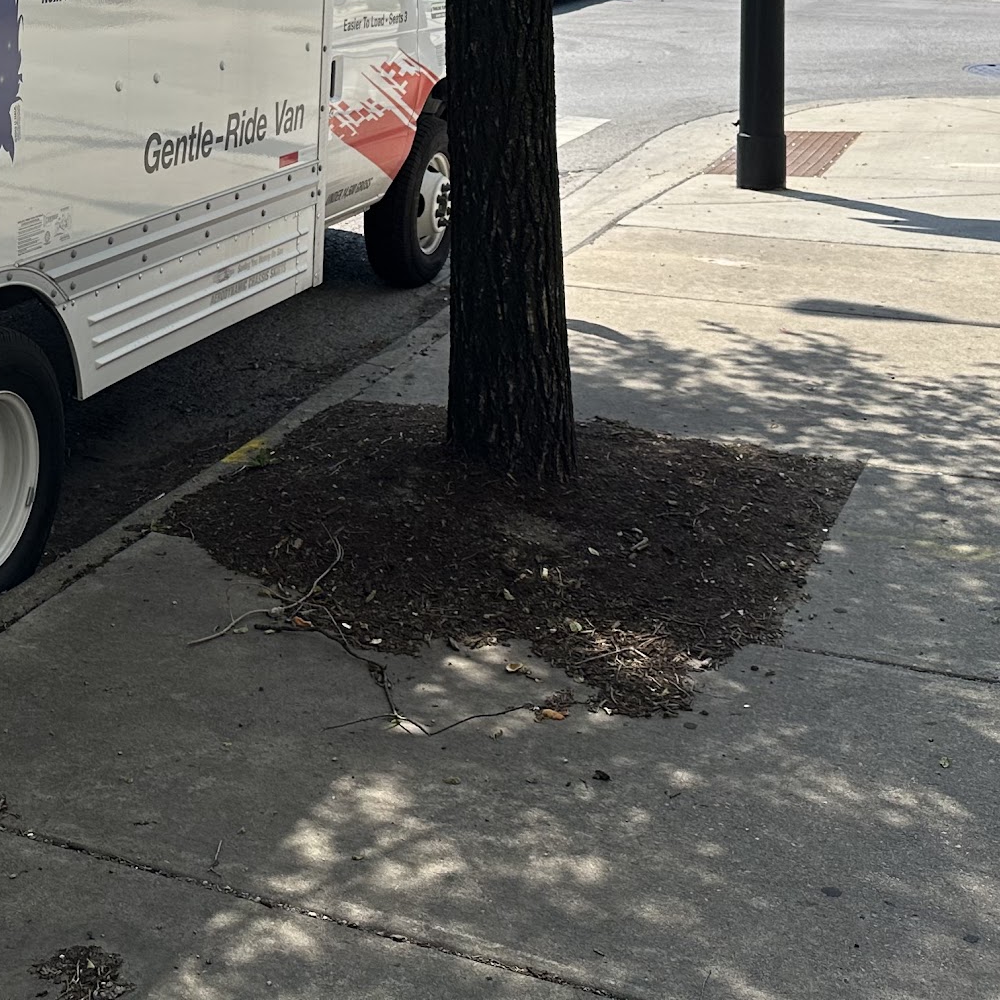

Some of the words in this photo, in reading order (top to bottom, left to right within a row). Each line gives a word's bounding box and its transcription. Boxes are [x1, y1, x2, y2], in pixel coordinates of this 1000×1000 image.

[343, 18, 362, 32] Easier
[363, 16, 370, 29] To
[371, 14, 385, 28] Load
[389, 12, 404, 26] Seats
[143, 106, 268, 175] Gentle-Ride
[275, 99, 305, 137] Van
